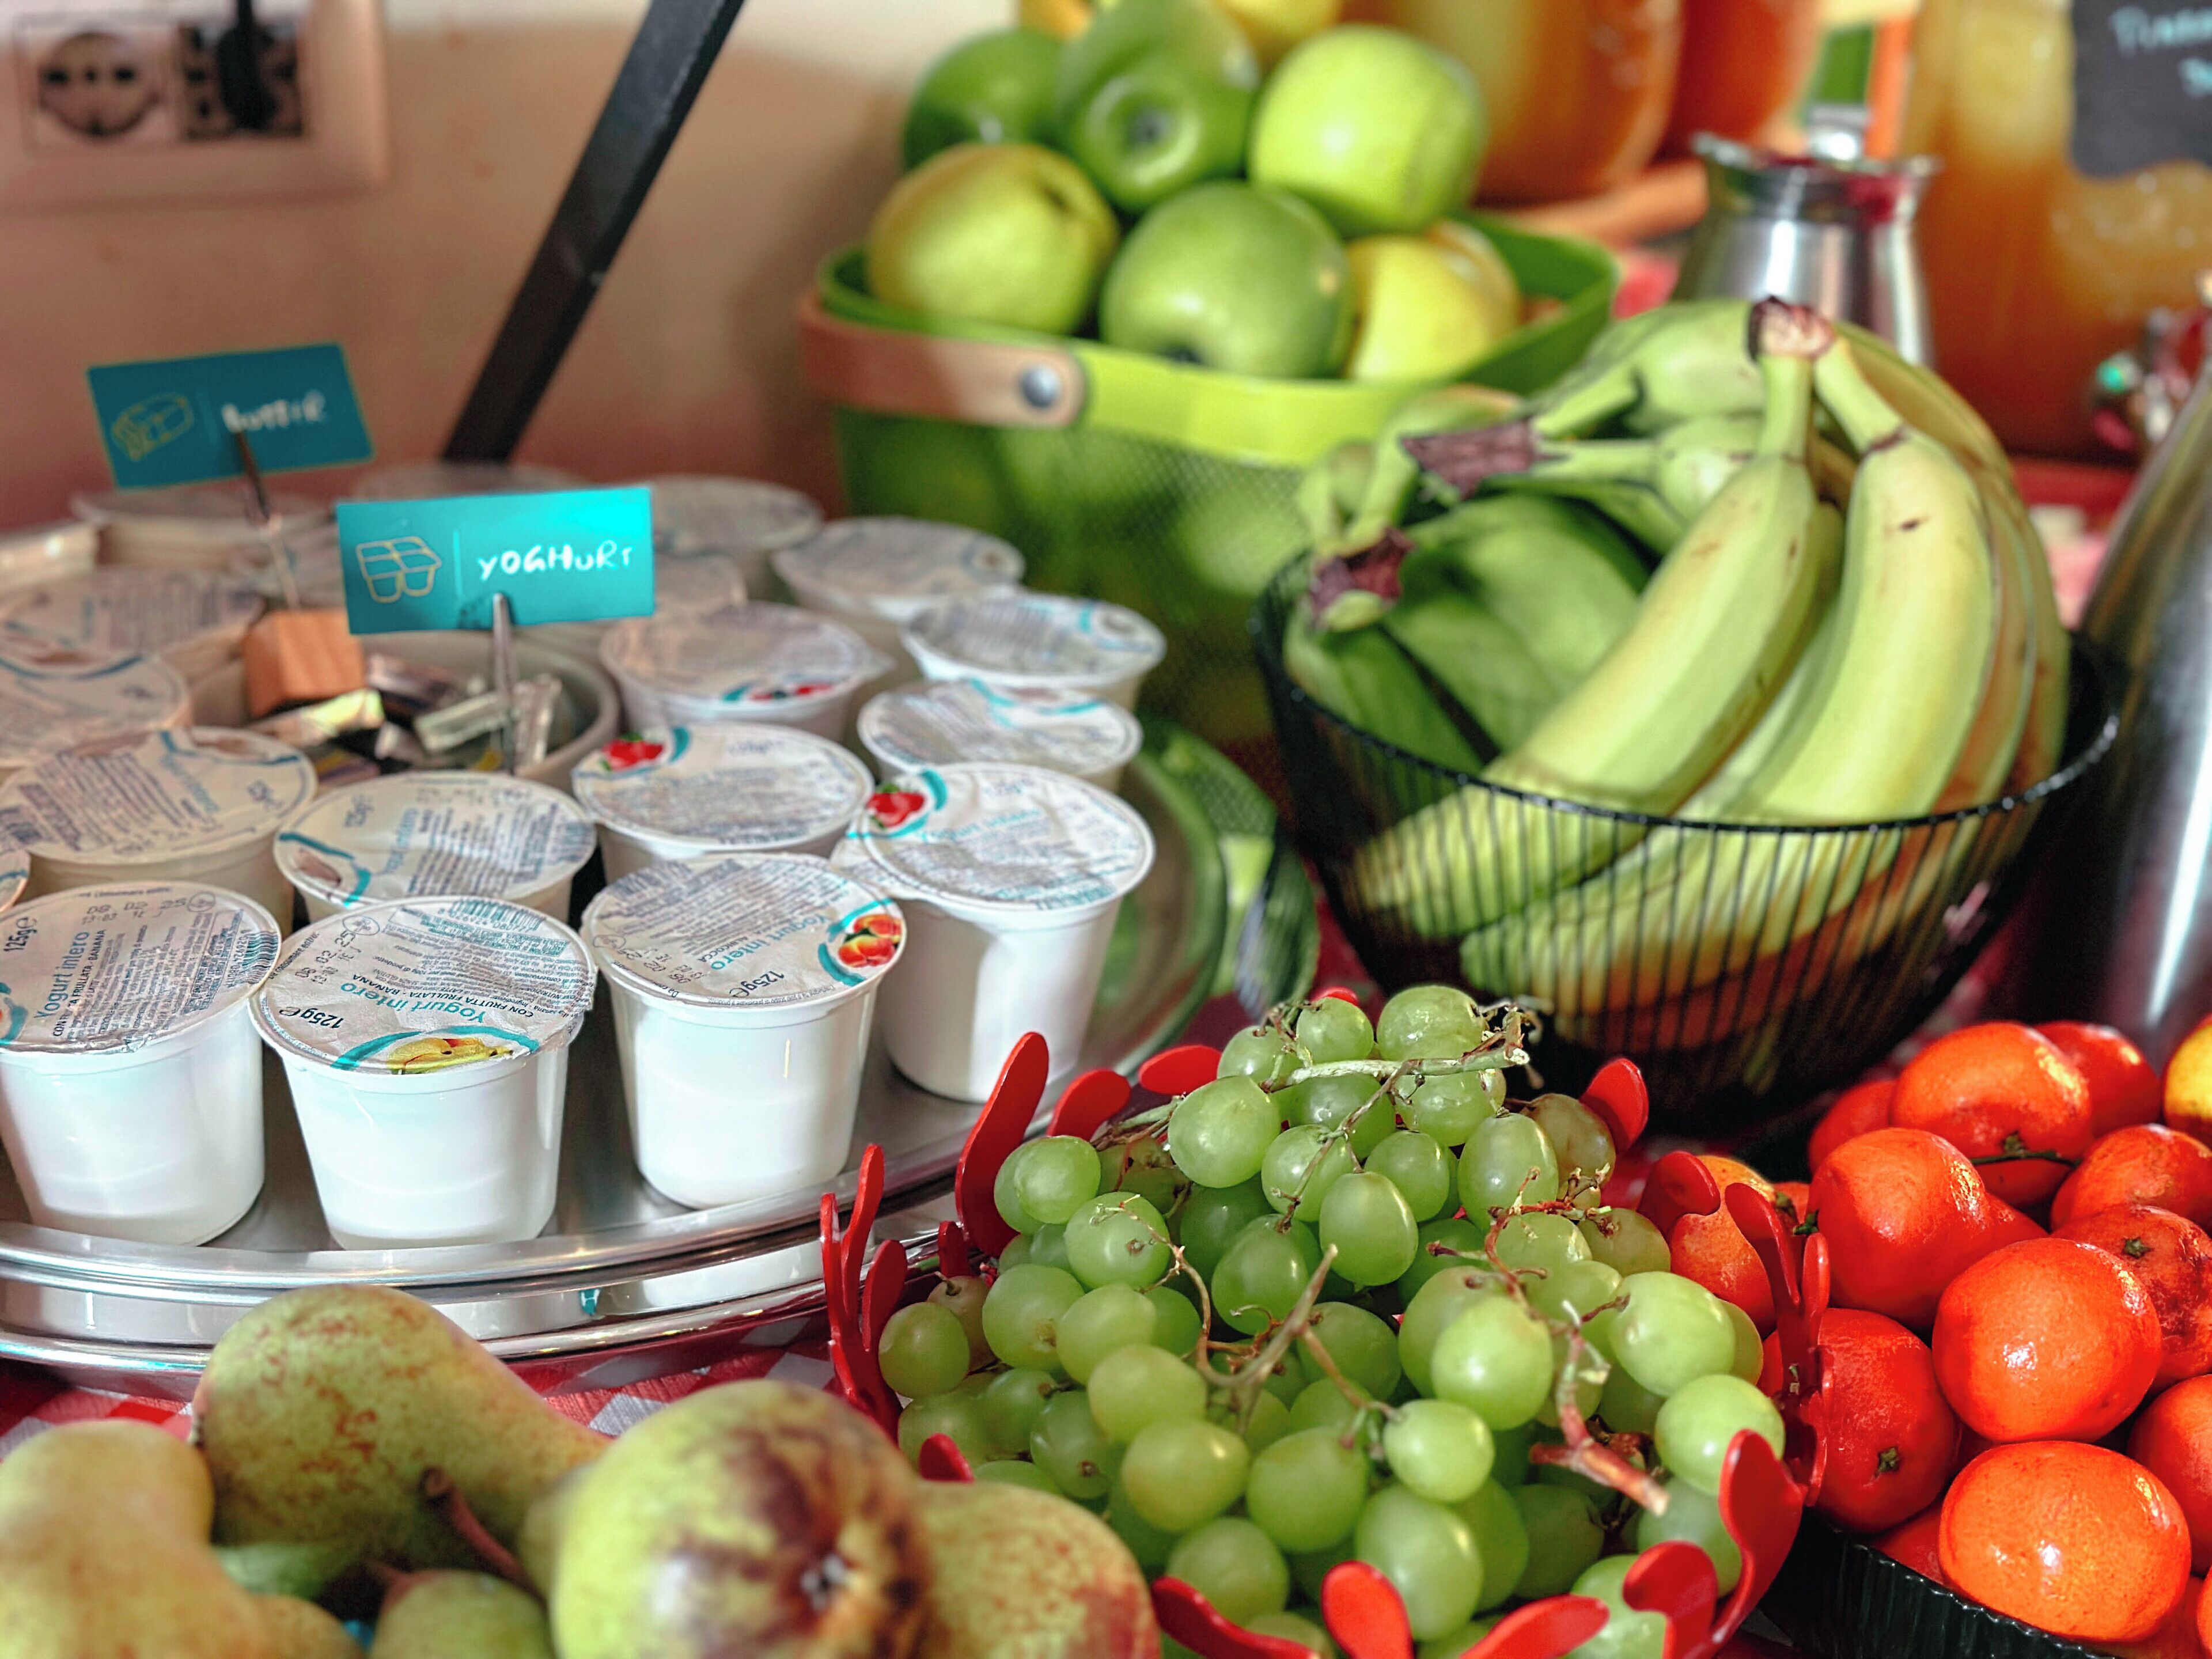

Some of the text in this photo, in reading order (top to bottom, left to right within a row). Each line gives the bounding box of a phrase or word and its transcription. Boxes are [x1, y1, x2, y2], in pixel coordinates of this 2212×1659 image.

[34, 931, 90, 1018] Yogurt intero
[711, 938, 770, 970] intero
[340, 982, 486, 1024] Yogurt intero
[353, 974, 534, 1018] CON FRUTTA FRULLATA BANANA
